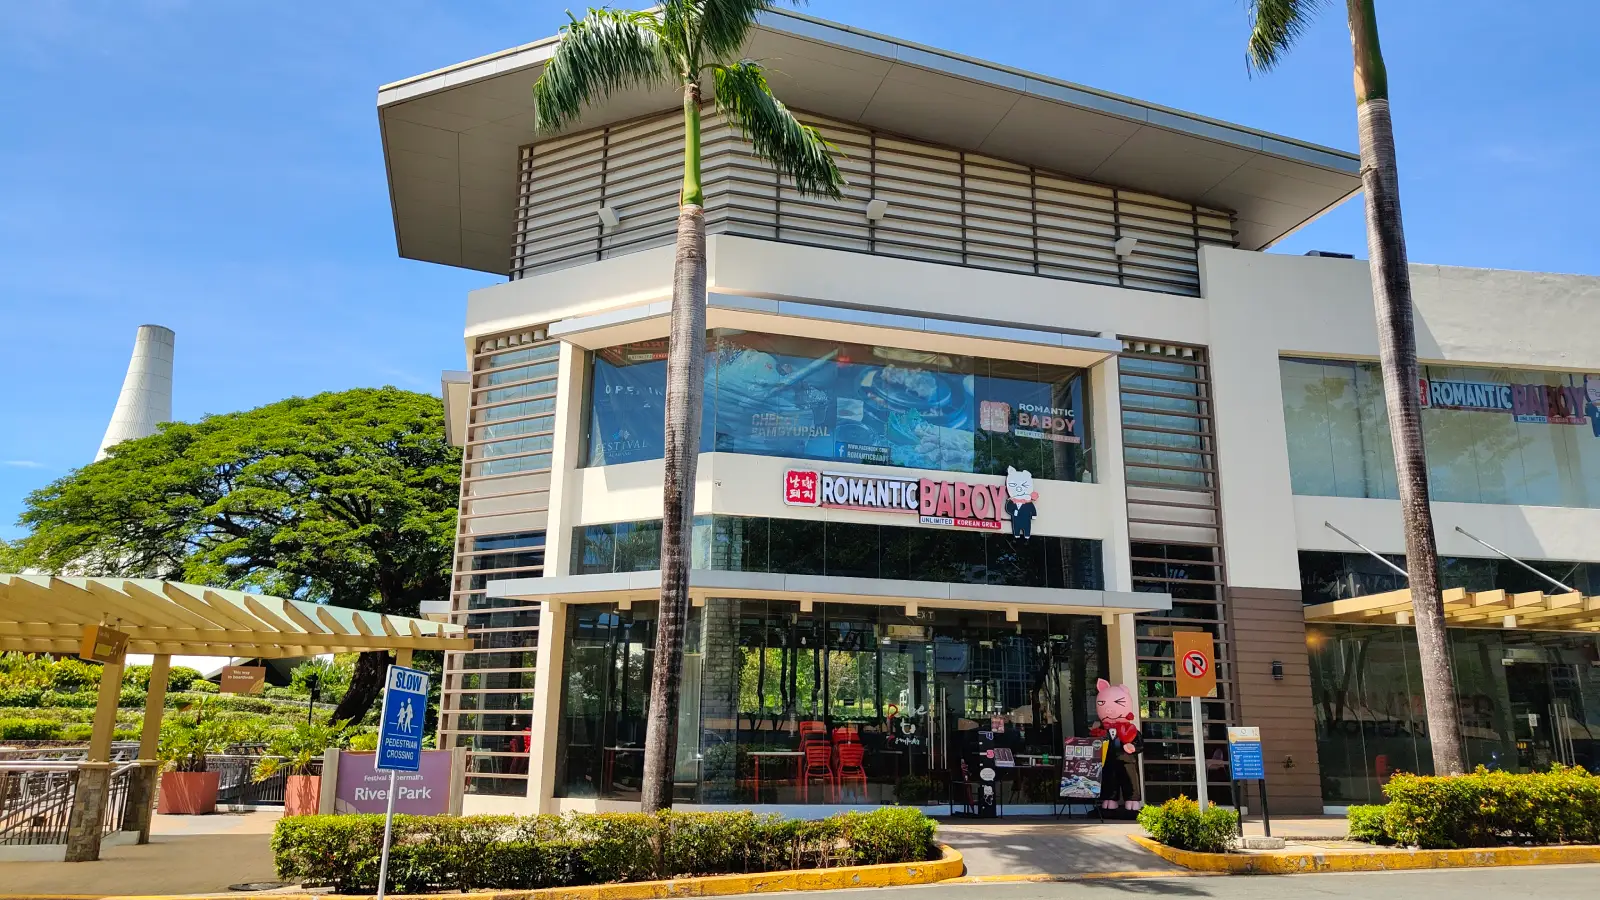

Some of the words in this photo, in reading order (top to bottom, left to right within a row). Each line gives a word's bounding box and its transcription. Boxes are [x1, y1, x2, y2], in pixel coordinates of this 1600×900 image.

[1432, 382, 1513, 410] ROMANTIC
[1512, 384, 1585, 419] BABOY
[1019, 403, 1075, 417] ROMANTIC
[1018, 412, 1076, 432] BABOY
[822, 476, 919, 510] ROMANTIC
[920, 478, 1007, 521] BABOY
[921, 517, 953, 525] UNLIMITED
[957, 519, 980, 527] KOREAN
[396, 671, 422, 691] SLOW
[385, 737, 418, 750] PEDESTRIAN
[386, 749, 414, 761] CROSSING
[364, 774, 387, 782] Festival
[354, 787, 392, 801] River
[398, 786, 432, 800] Park
